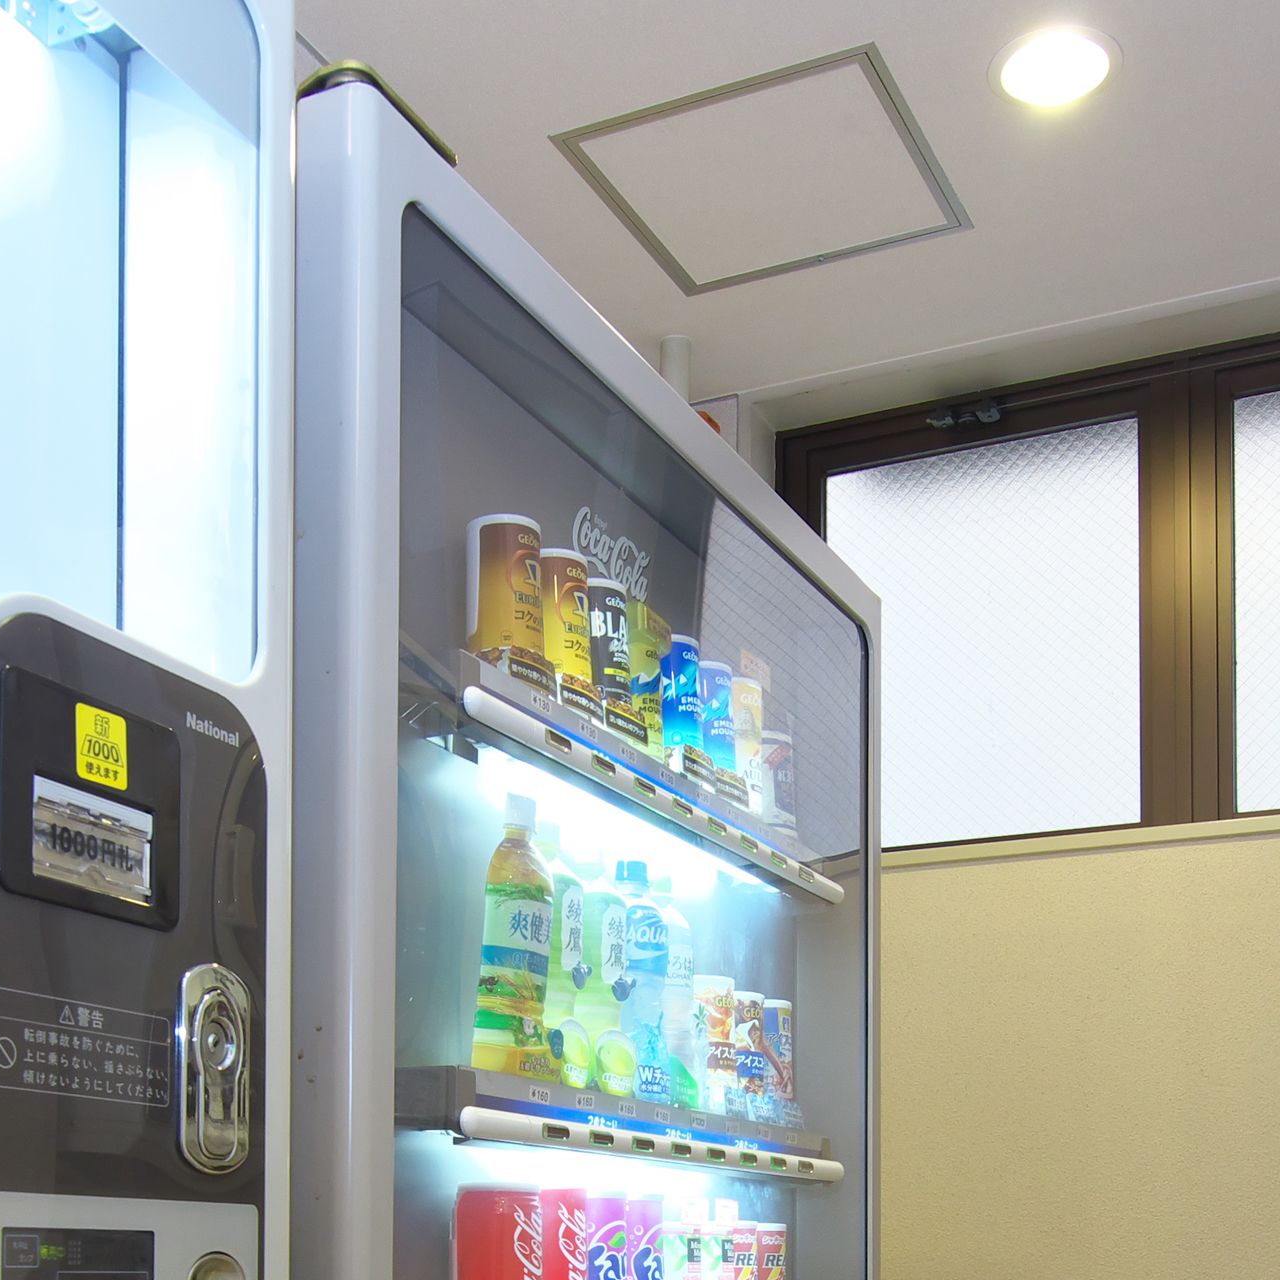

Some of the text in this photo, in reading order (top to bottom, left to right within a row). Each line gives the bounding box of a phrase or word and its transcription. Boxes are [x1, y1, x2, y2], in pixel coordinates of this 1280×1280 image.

[572, 506, 651, 603] Coca-Cola
[533, 694, 551, 713] ¥130
[94, 713, 111, 739] 新
[185, 711, 240, 748] National
[87, 738, 120, 763] 1000
[86, 760, 120, 782] 使えます
[49, 821, 134, 873] 1000円札
[567, 897, 583, 956] 綾鷹
[606, 916, 625, 970] 綾鷹
[77, 1007, 105, 1029] 警告
[24, 1027, 140, 1058] 転倒事故を防ぐために、
[23, 1070, 169, 1100] 傾けないようにしてください。
[532, 1087, 549, 1103] ¥160
